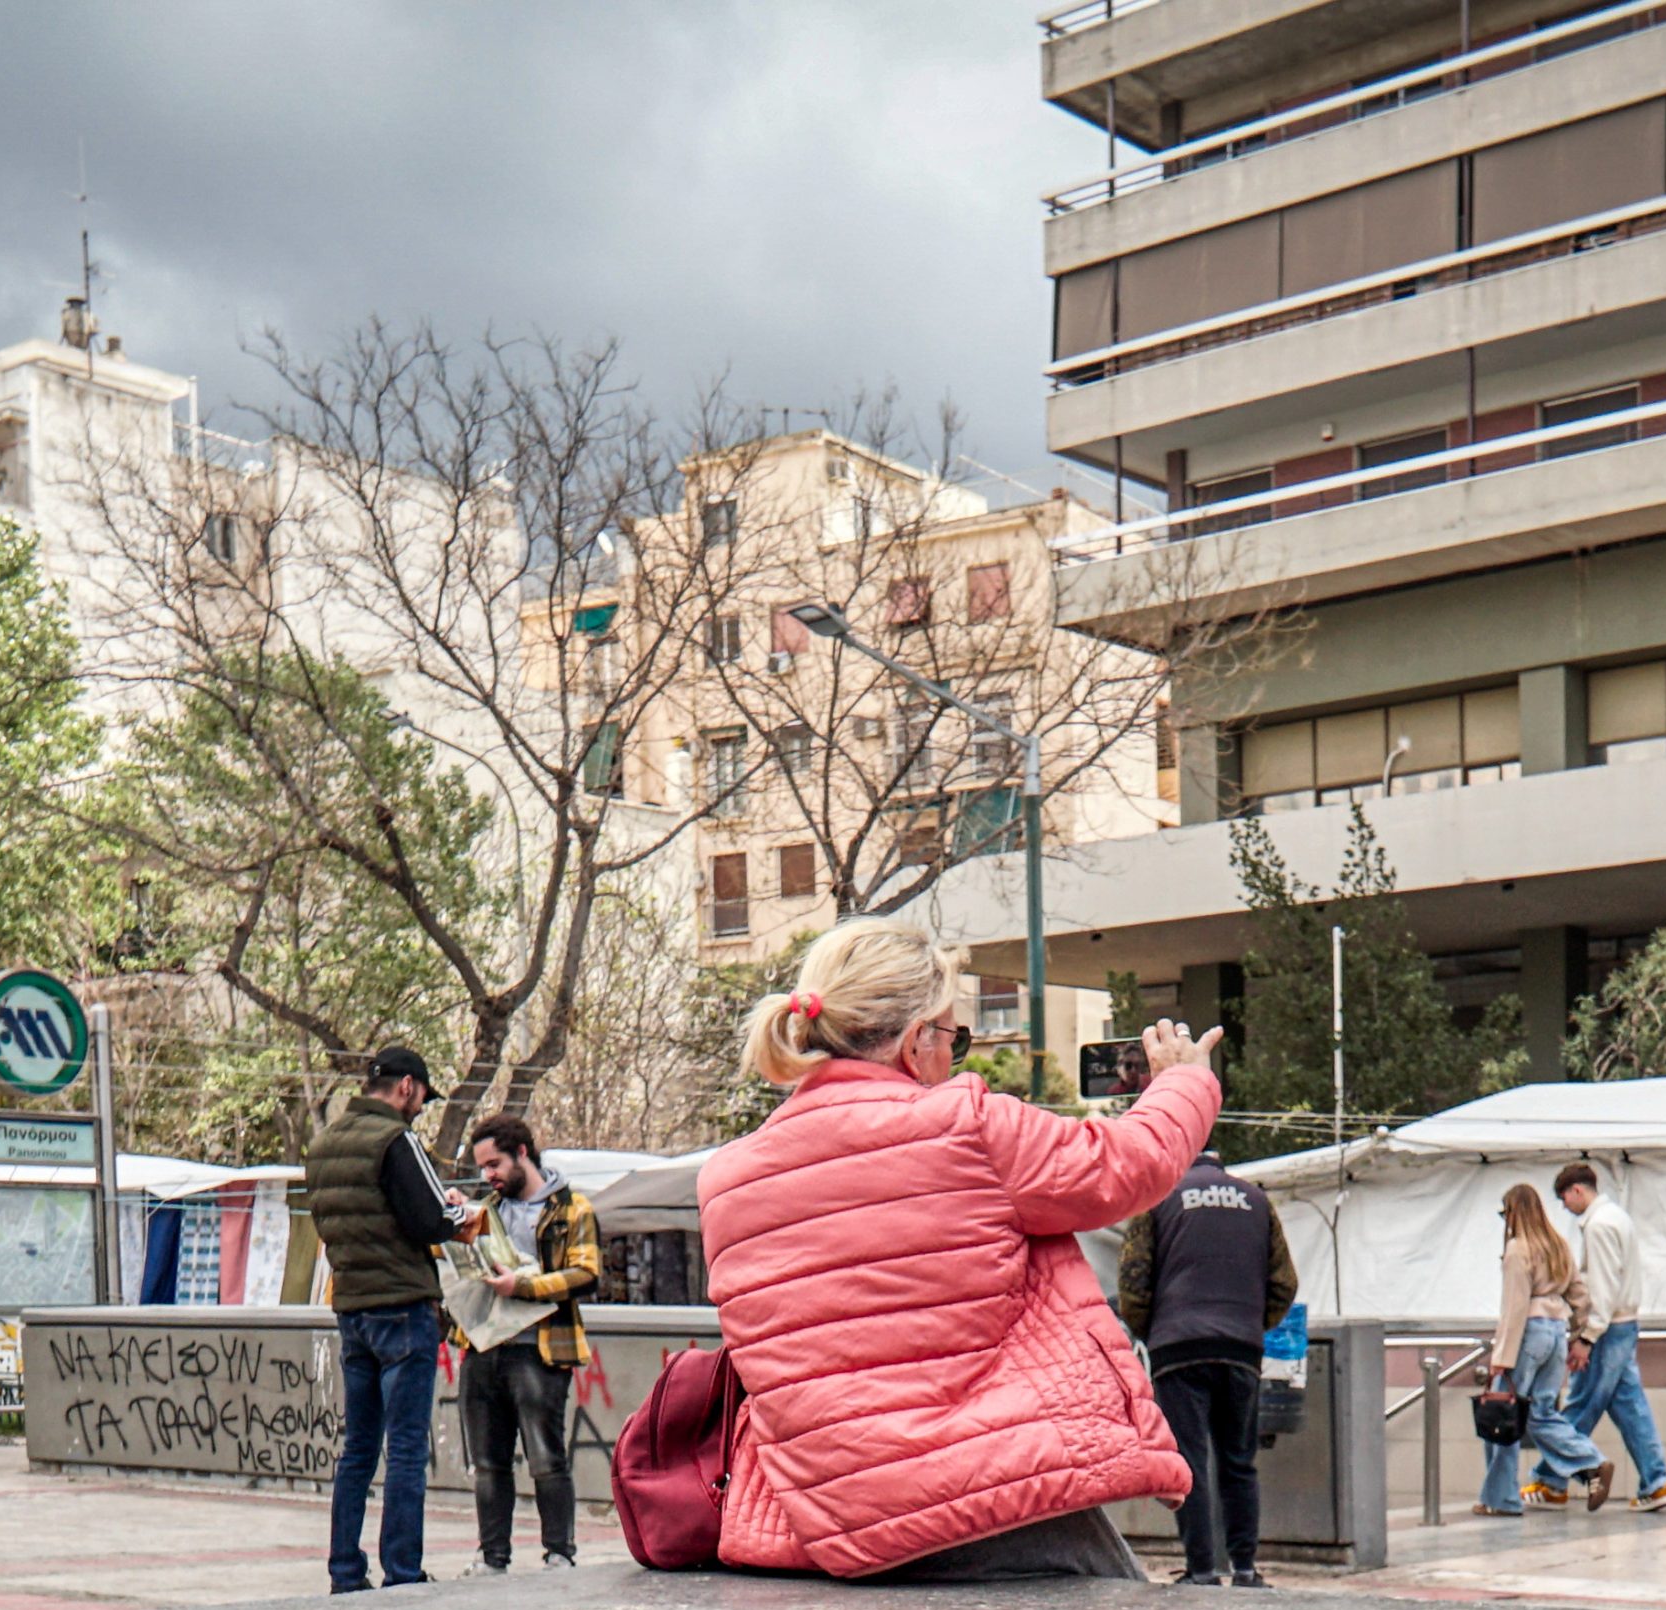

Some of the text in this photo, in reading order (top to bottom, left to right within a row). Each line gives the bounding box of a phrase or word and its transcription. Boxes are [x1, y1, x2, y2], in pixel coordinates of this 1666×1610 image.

[8, 1145, 68, 1160] Panormou
[50, 1332, 103, 1382] ΝΑ
[270, 1358, 319, 1404] ΤΟΥ
[65, 1399, 128, 1457] ΤΑ
